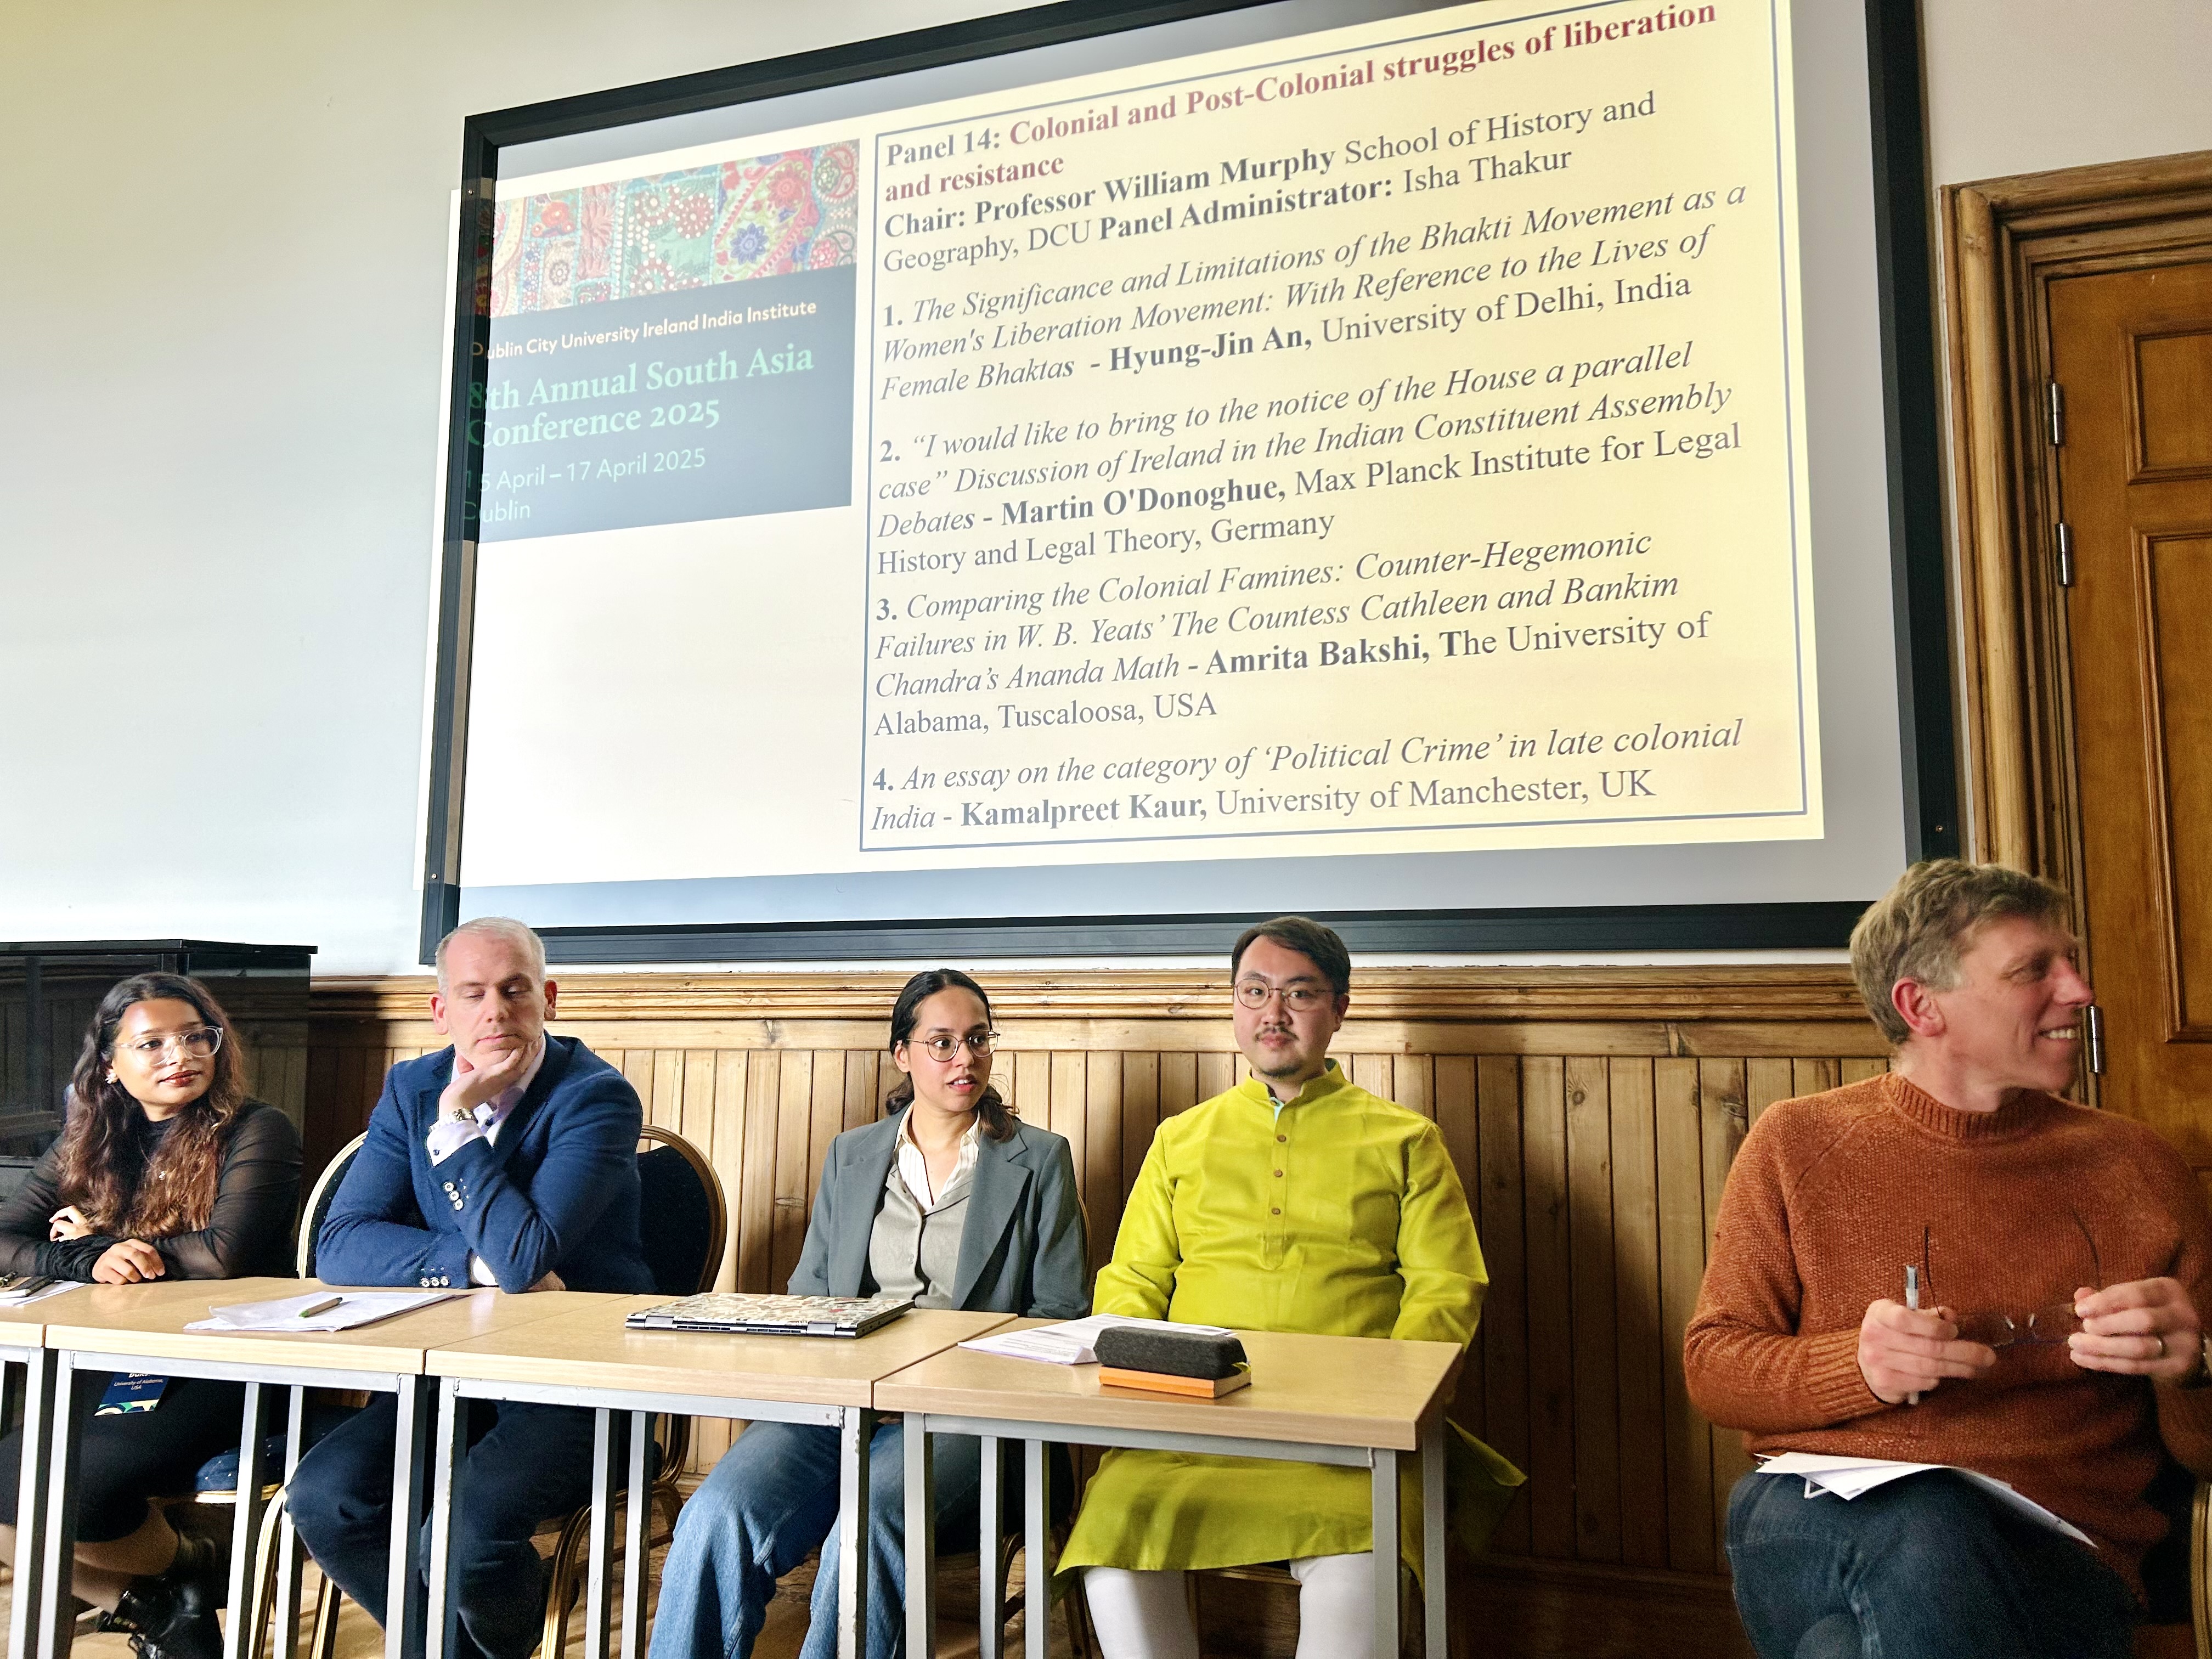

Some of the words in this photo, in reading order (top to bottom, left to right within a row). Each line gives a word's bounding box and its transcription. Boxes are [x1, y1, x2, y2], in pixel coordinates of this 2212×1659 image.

[887, 134, 955, 167] Panel
[964, 128, 1000, 153] 14:
[1010, 105, 1118, 145] Colonial
[1128, 95, 1176, 125] and
[1186, 60, 1374, 114] Post-Colonial
[1383, 40, 1515, 81] struggles
[1525, 26, 1558, 55] of
[1563, 4, 1716, 48] liberation
[885, 207, 964, 237] Chair:
[975, 190, 1096, 224] Professor
[1103, 171, 1210, 202] William
[1220, 148, 1336, 185] Murphy
[1345, 127, 1438, 164] School
[1448, 119, 1481, 147] of
[1485, 108, 1593, 142] History
[1603, 90, 1656, 122] and
[885, 173, 930, 202] and
[940, 157, 1064, 193] resistance
[884, 235, 1018, 272] Geography,
[1028, 219, 1091, 251] DCU
[1099, 207, 1173, 240] Panel
[1180, 179, 1391, 228] Administrator:
[1403, 165, 1460, 194] Isha
[1468, 150, 1572, 183] Thakur
[884, 304, 902, 326] 1.
[913, 298, 955, 323] The
[963, 280, 1113, 319] Significance
[1121, 263, 1171, 293] and
[1175, 249, 1325, 286] Limitations
[1334, 234, 1368, 268] of
[1369, 231, 1411, 257] the
[1419, 216, 1512, 251] Bhakti
[1520, 193, 1674, 235] Movement
[1683, 191, 1716, 211] as
[1726, 186, 1746, 205] a
[885, 329, 984, 363] Women's
[991, 315, 1121, 349] Liberation
[1130, 291, 1273, 330] Movement:
[1287, 277, 1345, 308] With
[1353, 259, 1491, 302] Reference
[1501, 256, 1527, 279] to
[1538, 246, 1582, 273] the
[1589, 239, 1668, 266] Lives
[1679, 224, 1716, 259] of
[527, 338, 557, 354] City
[562, 326, 639, 348] University
[643, 314, 698, 338] Ireland
[702, 310, 742, 329] India
[747, 301, 816, 324] Institute
[880, 368, 969, 399] Female
[975, 358, 1074, 388] Bhaktas
[1109, 331, 1254, 374] Hyung-Jin
[1261, 326, 1312, 351] An,
[1321, 303, 1466, 342] University
[1476, 294, 1509, 322] of
[1514, 285, 1604, 318] Delhi,
[1613, 272, 1692, 304] India
[469, 380, 520, 409] 8th
[527, 362, 637, 405] Annual
[646, 350, 739, 390] South
[746, 343, 814, 377] Asia
[880, 440, 900, 462] 2.
[943, 424, 1018, 455] would
[1024, 420, 1068, 446] like
[1076, 420, 1099, 440] to
[1109, 412, 1177, 437] bring
[1186, 407, 1209, 427] to
[1219, 398, 1258, 424] the
[1267, 390, 1349, 417] notice
[1358, 378, 1392, 412] of
[1394, 375, 1436, 402] the
[1443, 368, 1537, 396] House
[1546, 365, 1564, 383] a
[1568, 340, 1693, 388] parallel
[467, 410, 641, 447] Conference
[650, 399, 719, 428] 2025
[953, 461, 1088, 492] Discussion
[1097, 450, 1128, 482] of
[1128, 439, 1226, 473] Ireland
[1232, 440, 1256, 462] in
[1266, 432, 1306, 458] the
[1313, 422, 1404, 453] Indian
[1415, 400, 1580, 440] Constituent
[1585, 381, 1732, 421] Assembly
[496, 464, 545, 493] April
[567, 461, 590, 481] 17
[597, 452, 646, 482] April
[654, 448, 705, 472] 2025
[877, 511, 975, 538] Debates
[1001, 495, 1094, 526] Martin
[1104, 478, 1285, 515] O'Donoghue,
[1295, 469, 1357, 495] Max
[1365, 454, 1463, 488] Planck
[1470, 444, 1590, 477] Institute
[1600, 435, 1645, 462] for
[1653, 421, 1741, 459] Legal
[876, 599, 897, 620] 3.
[907, 590, 1045, 621] Comparing
[1052, 582, 1090, 607] the
[1099, 569, 1211, 602] Colonial
[1217, 565, 1343, 592] Famines:
[1356, 532, 1651, 579] Counter-Hegemonic
[877, 543, 967, 574] History
[975, 539, 1018, 566] and
[1026, 532, 1096, 564] Legal
[1104, 528, 1201, 554] Theory,
[1211, 515, 1335, 543] Germany
[874, 633, 975, 659] Failures
[985, 630, 1007, 651] in
[1018, 624, 1044, 648] W.
[1052, 622, 1076, 646] B.
[1171, 611, 1218, 637] The
[1228, 605, 1350, 631] Countess
[1361, 589, 1487, 620] Cathleen
[1497, 579, 1555, 610] and
[1561, 572, 1678, 605] Bankim
[1005, 659, 1104, 689] Ananda
[1111, 653, 1179, 681] Math
[1205, 645, 1308, 675] Amrita
[1318, 634, 1430, 667] Bakshi,
[1439, 630, 1497, 657] The
[1505, 616, 1667, 651] University
[1677, 611, 1712, 639] of
[873, 709, 989, 736] Alabama,
[997, 699, 1143, 728] Tuscaloosa,
[1153, 692, 1218, 718] USA
[873, 768, 893, 791] 4.
[900, 765, 935, 790] An
[944, 769, 1010, 792] essay
[1018, 766, 1048, 783] on
[1057, 757, 1094, 781] the
[1103, 757, 1216, 783] category
[1225, 747, 1257, 780] of
[1509, 735, 1536, 758] in
[1547, 729, 1603, 755] late
[1613, 718, 1743, 752] colonial
[872, 805, 935, 830] India
[961, 798, 1120, 829] Kamalpreet
[1128, 794, 1206, 821] Kaur,
[1216, 785, 1361, 816] University
[1370, 781, 1403, 808] of
[1408, 776, 1588, 806] Manchester,
[1598, 769, 1657, 797] UK
